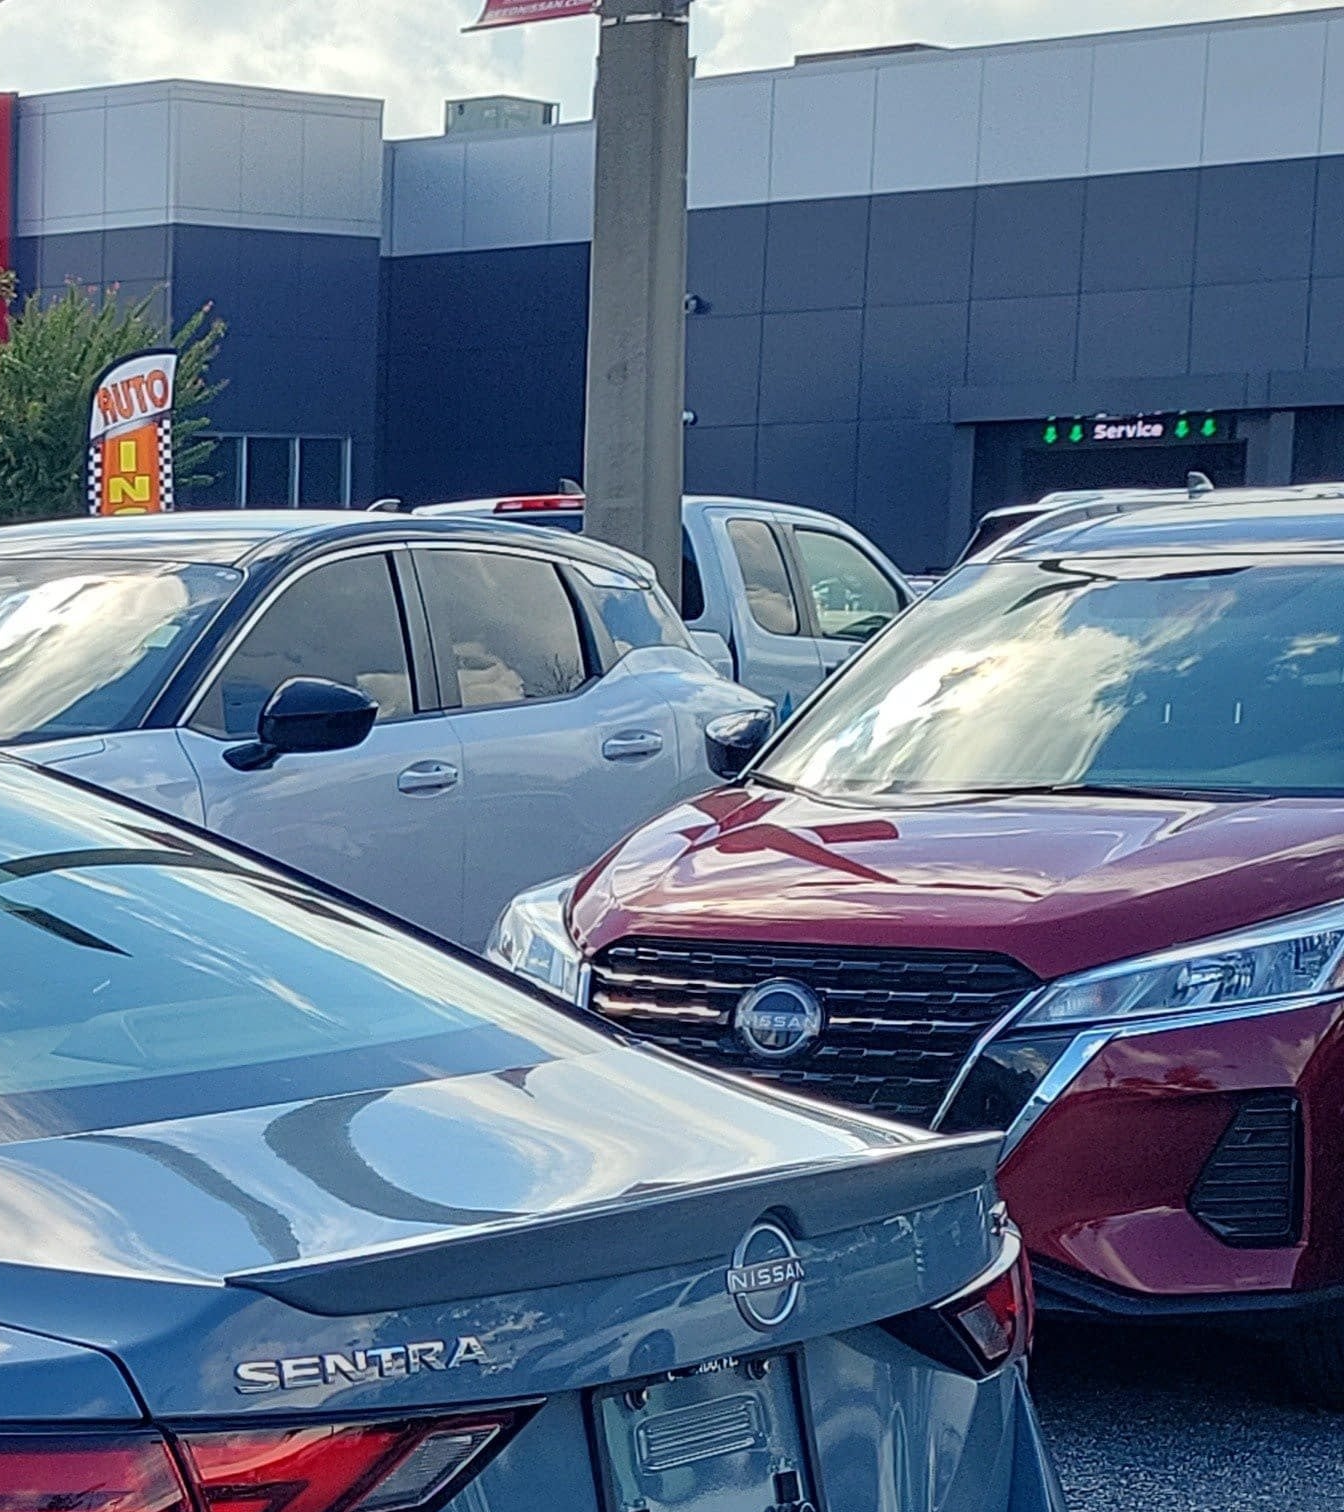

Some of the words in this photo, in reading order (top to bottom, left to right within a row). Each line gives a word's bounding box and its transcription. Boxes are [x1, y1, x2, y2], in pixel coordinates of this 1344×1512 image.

[97, 369, 169, 426] AUTO
[1093, 420, 1163, 440] Service
[108, 440, 151, 515] IN
[742, 1015, 817, 1029] NISSAN
[731, 1260, 805, 1292] NISSAN
[234, 1335, 488, 1395] SENTRA
